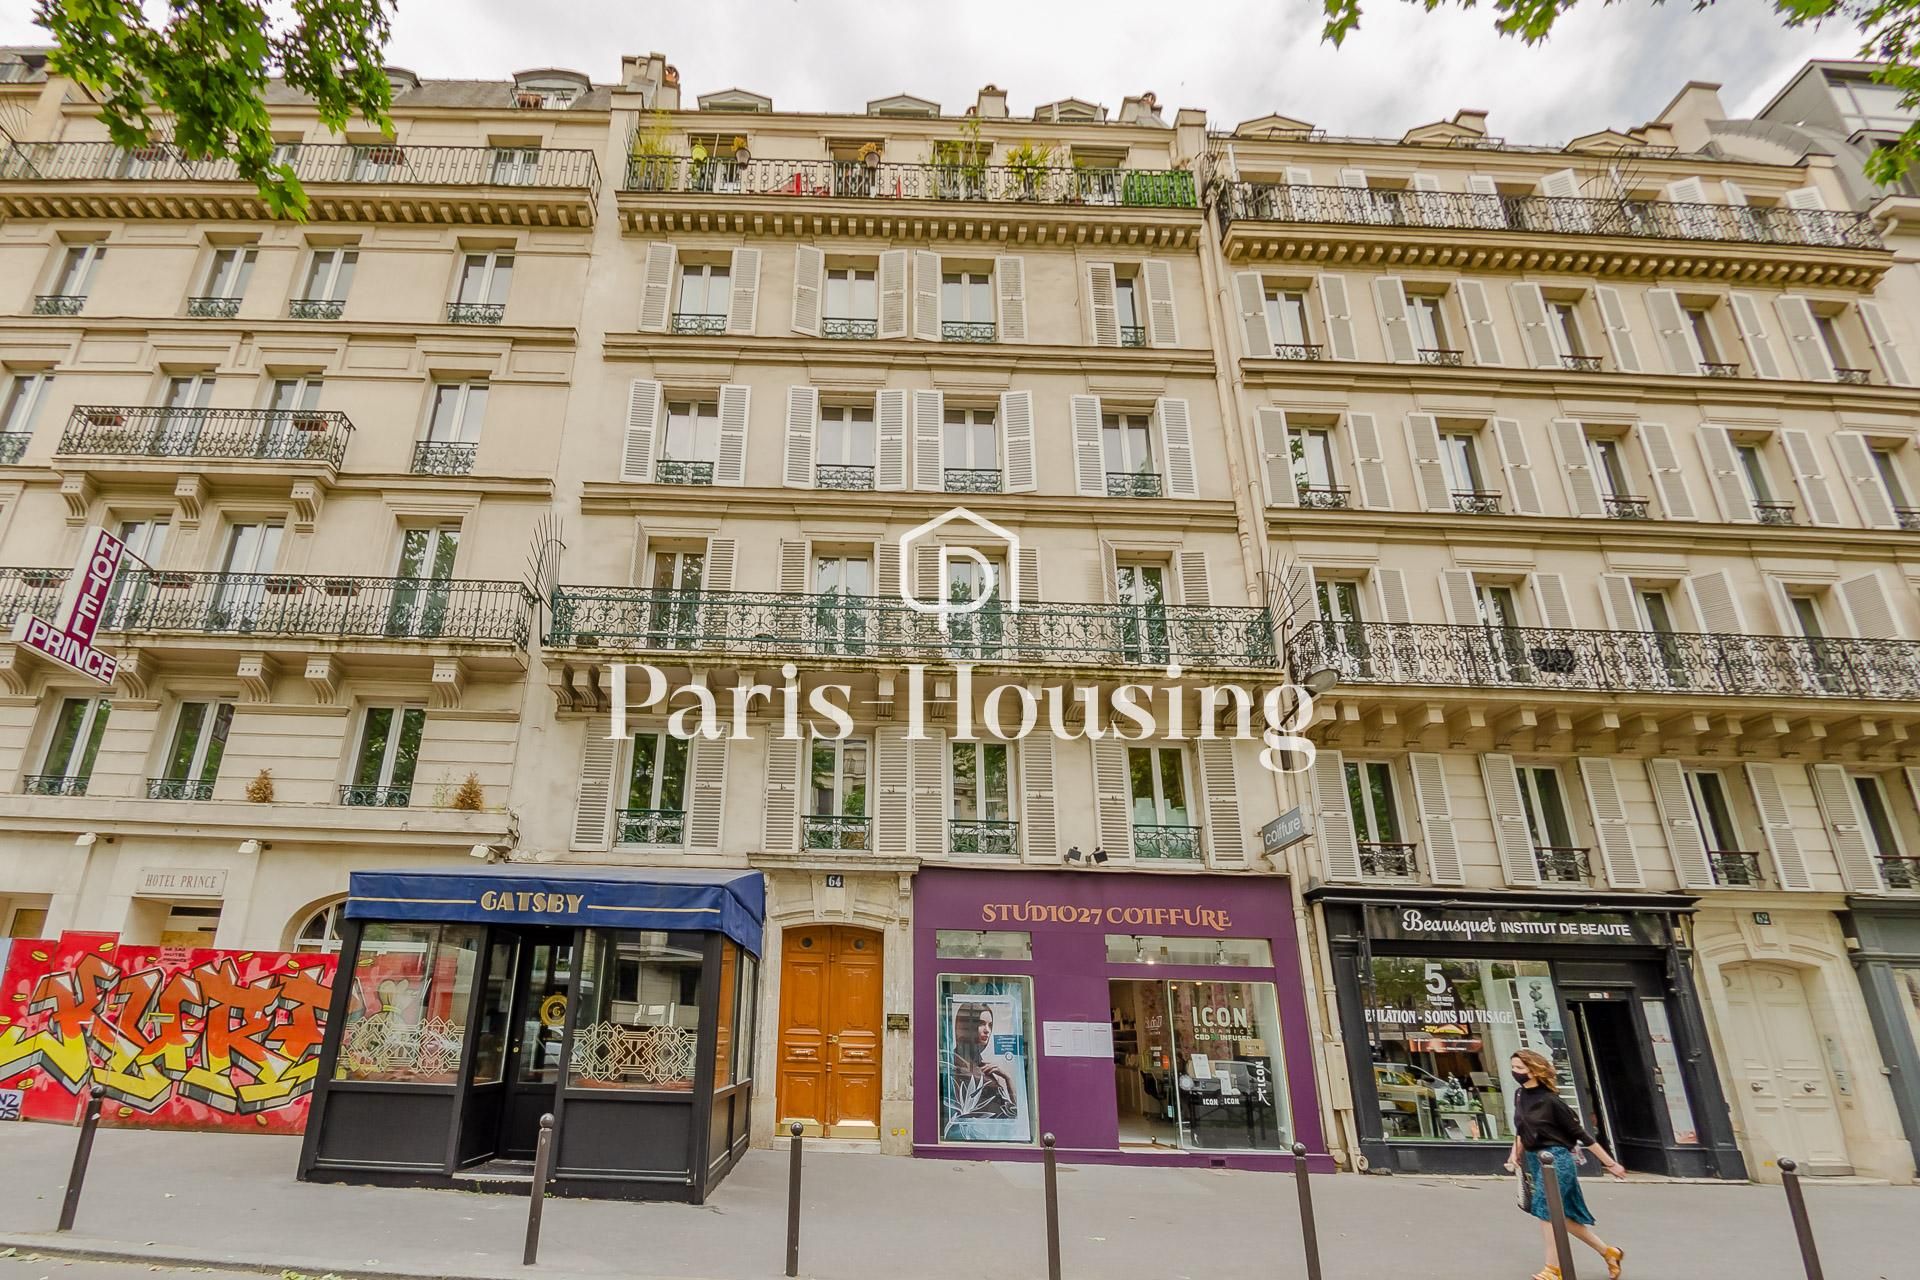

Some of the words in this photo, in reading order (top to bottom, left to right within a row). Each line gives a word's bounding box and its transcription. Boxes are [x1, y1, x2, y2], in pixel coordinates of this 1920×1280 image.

[71, 534, 120, 640] HOTEL
[27, 620, 116, 683] PRINCE
[1265, 818, 1300, 845] coiffure
[145, 874, 175, 887] HOTEL
[180, 876, 217, 888] PRINCE
[828, 875, 842, 887] 64
[480, 890, 585, 913] GATSBY
[1106, 905, 1232, 931] COIFFURE
[1402, 909, 1497, 940] Beausquet
[1501, 921, 1556, 934] INSTITUT
[1560, 923, 1577, 934] DE
[1580, 924, 1631, 936] BEAUTE
[1424, 1010, 1459, 1024] SOINS
[1460, 1010, 1475, 1023] DU
[1476, 1010, 1513, 1024] VISAGE
[1255, 1060, 1267, 1088] ICON
